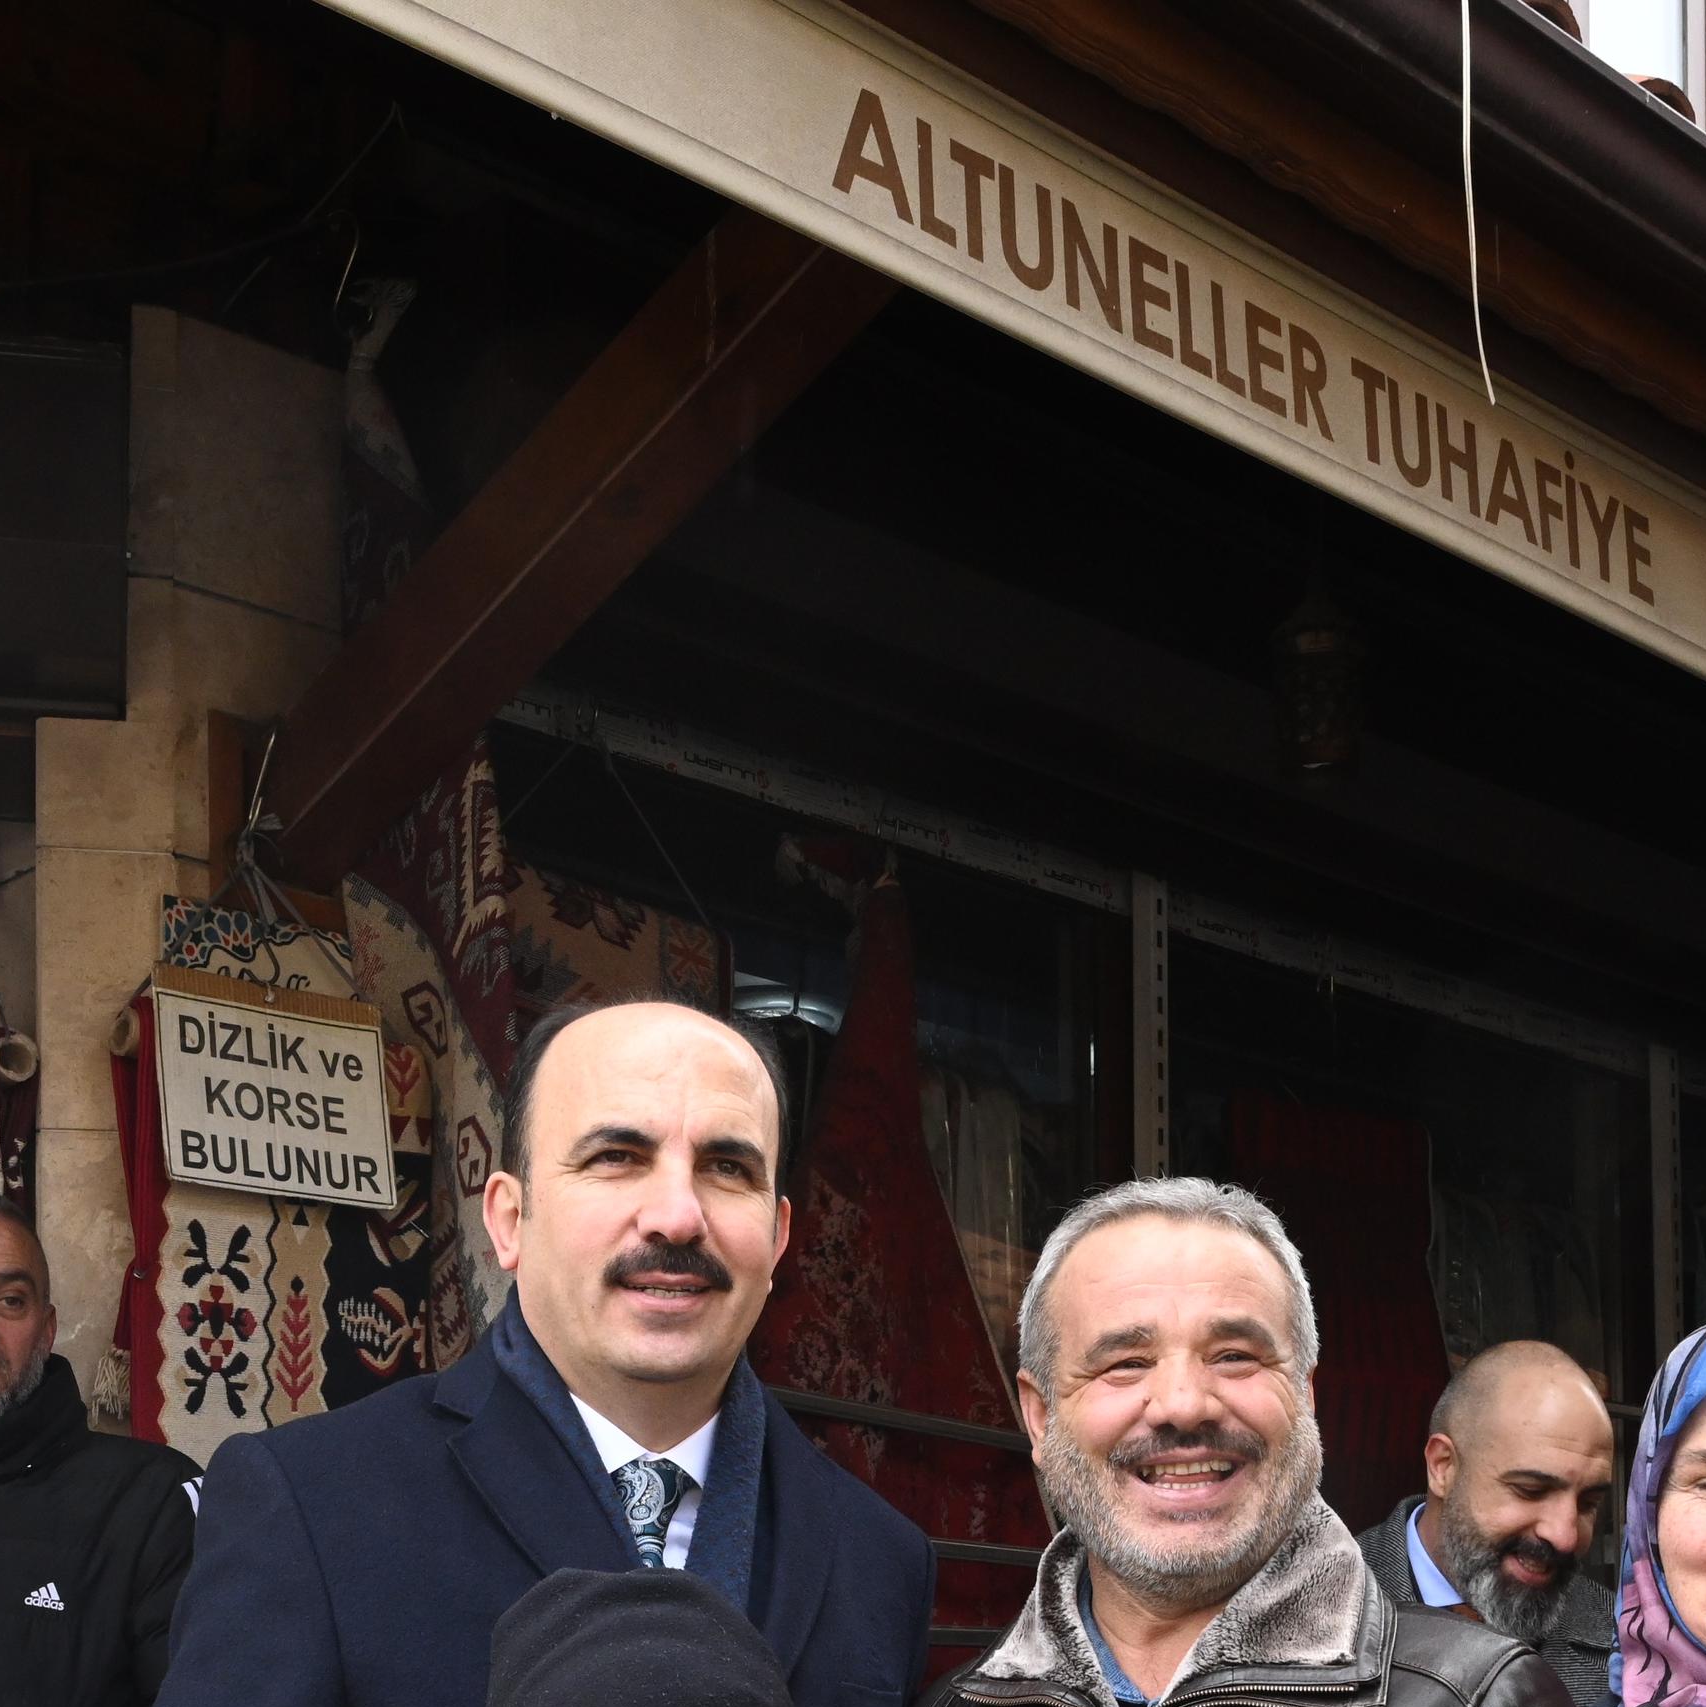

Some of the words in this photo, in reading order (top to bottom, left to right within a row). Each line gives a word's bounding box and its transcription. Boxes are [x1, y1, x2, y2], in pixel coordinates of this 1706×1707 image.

[831, 87, 1335, 442] ALTUNELLER
[1351, 356, 1656, 607] TUHAFİYE
[178, 1011, 309, 1074] DİZLİK
[318, 1048, 364, 1082] ve
[204, 1076, 348, 1135] KORSE
[180, 1129, 382, 1194] BULUNUR
[24, 1596, 65, 1611] adidas
